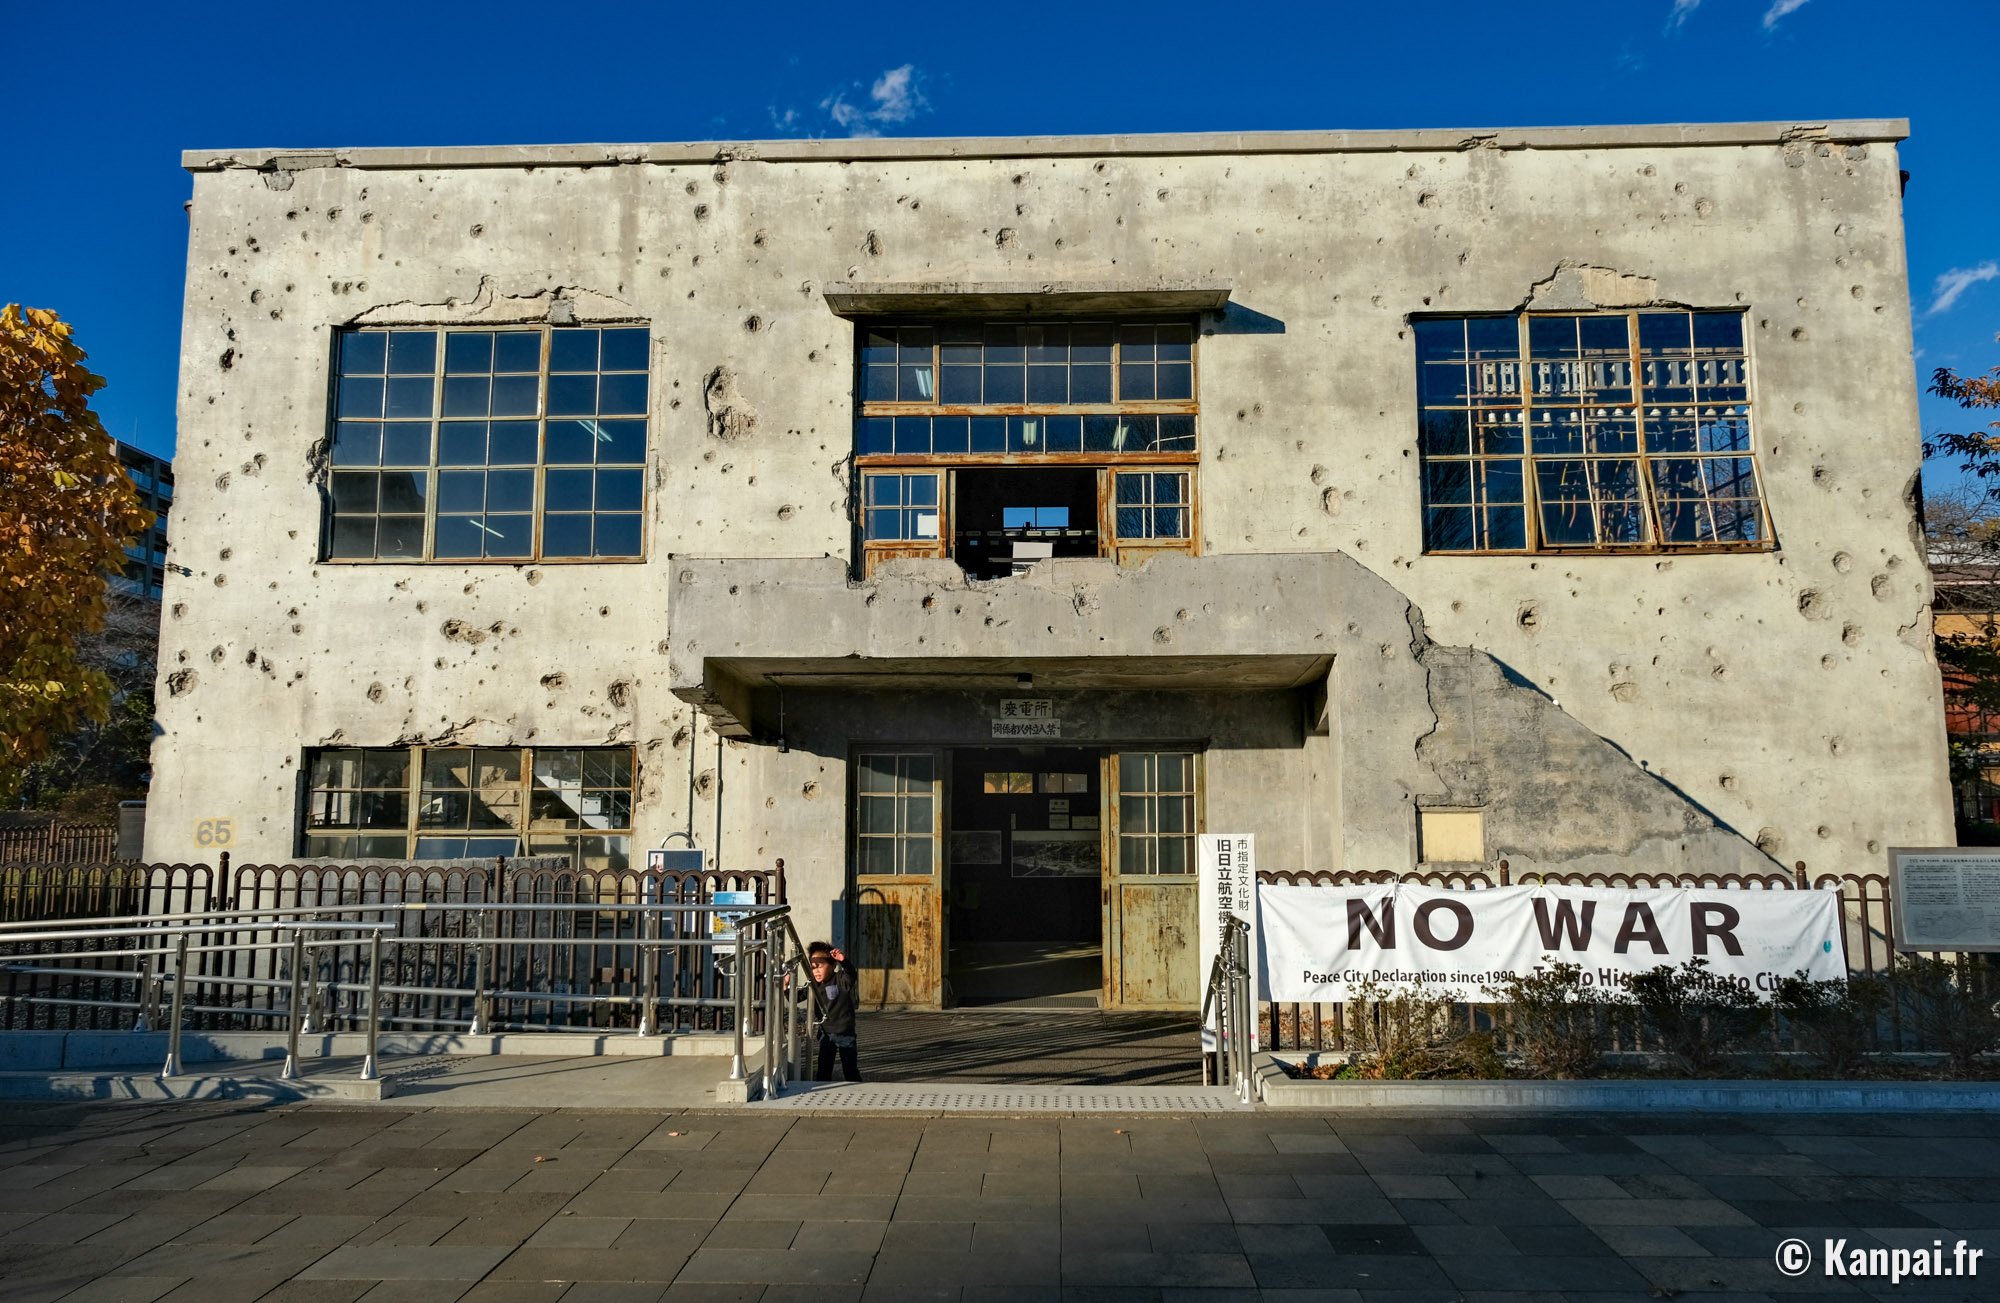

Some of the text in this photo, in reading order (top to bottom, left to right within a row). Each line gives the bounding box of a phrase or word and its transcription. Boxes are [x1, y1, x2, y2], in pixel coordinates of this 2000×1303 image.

[197, 820, 231, 846] 65
[1237, 839, 1250, 911] 市指定文化財
[1346, 896, 1744, 956] NO WAR
[1303, 970, 1341, 984] Peace
[1343, 969, 1369, 986] City
[1372, 968, 1447, 983] Declaration
[1533, 966, 1594, 993] Tyo
[1756, 972, 1786, 992] Cit
